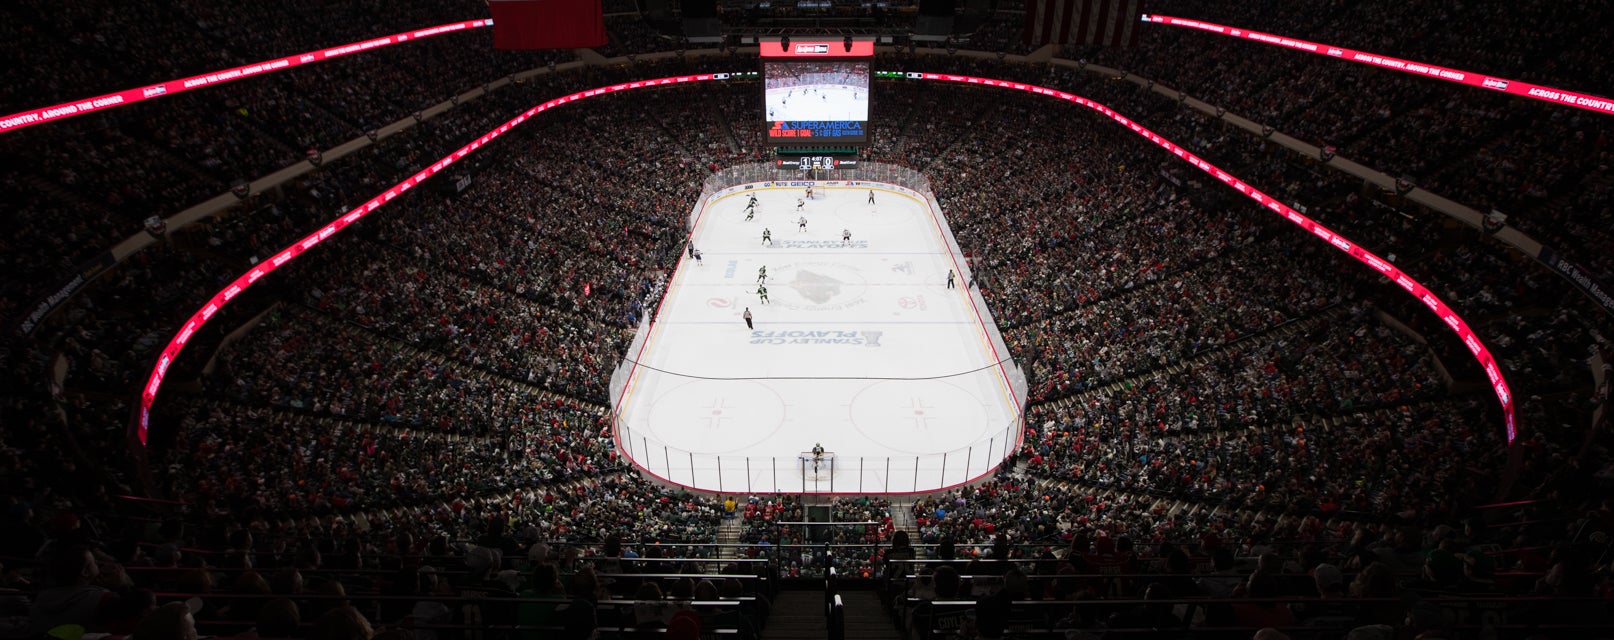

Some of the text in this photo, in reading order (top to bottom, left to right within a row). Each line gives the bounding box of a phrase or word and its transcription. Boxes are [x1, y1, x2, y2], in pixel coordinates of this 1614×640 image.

[1528, 88, 1560, 100] ACROSS
[1560, 94, 1577, 103] THE
[42, 105, 77, 120] AROUND
[77, 102, 93, 111] THE
[94, 95, 124, 108] CORNER
[792, 121, 860, 129] SUPERAMERICA
[1557, 259, 1614, 310] RBC Wealth Manage
